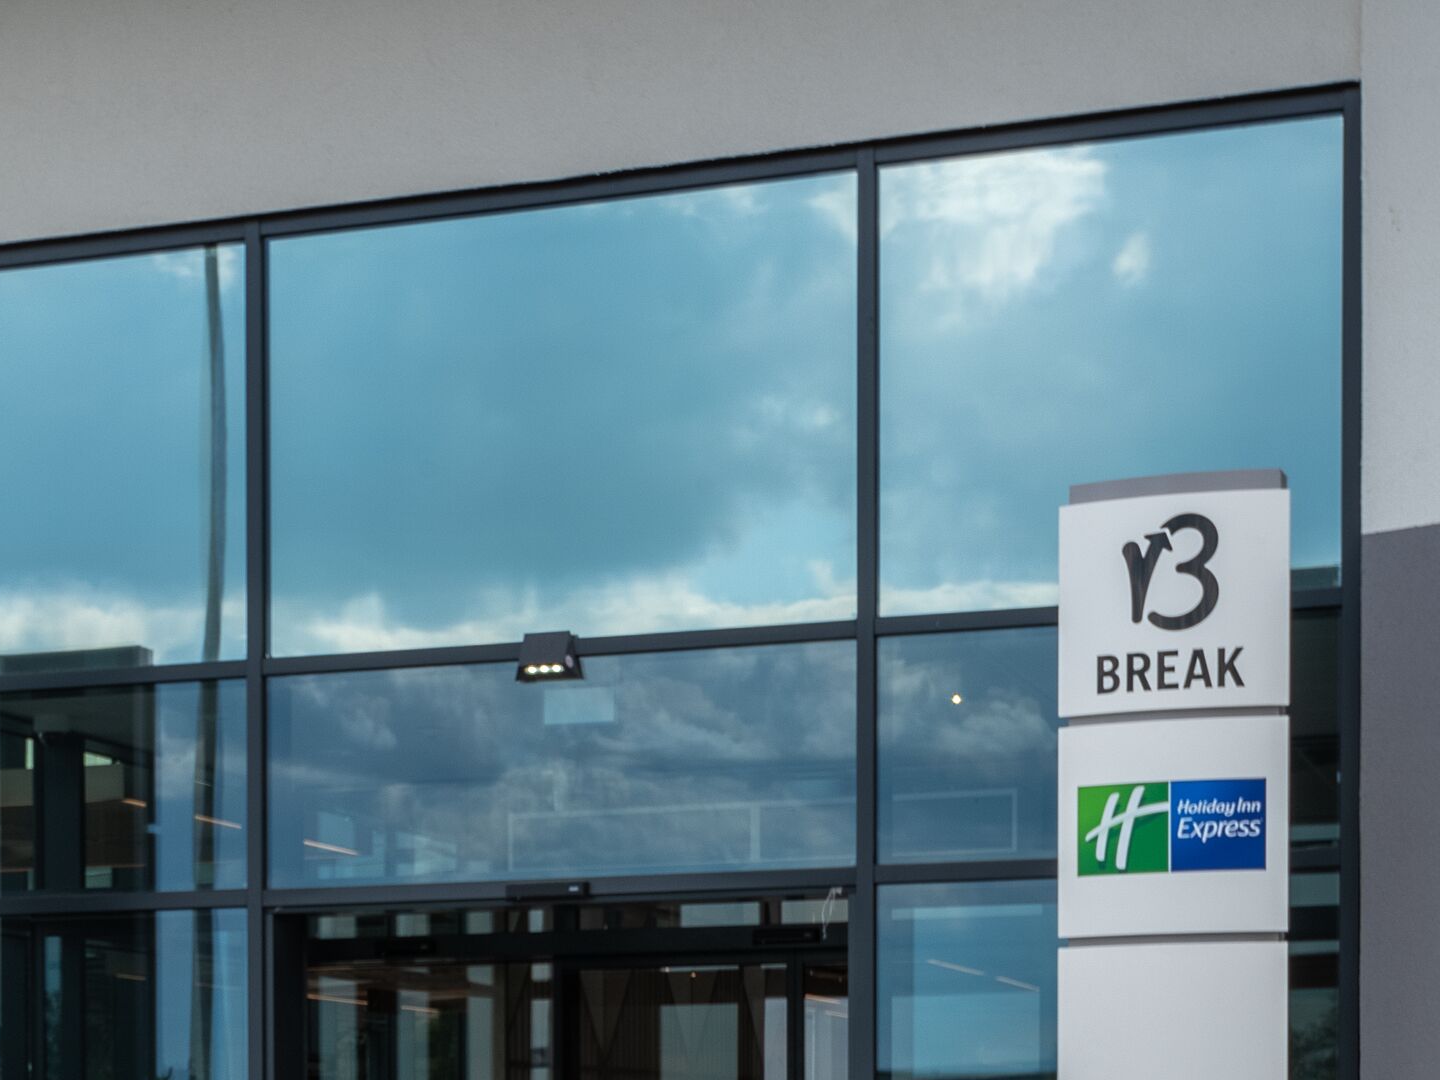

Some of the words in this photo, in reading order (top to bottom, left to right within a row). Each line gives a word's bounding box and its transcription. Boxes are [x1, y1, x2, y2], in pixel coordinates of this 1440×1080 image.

[1096, 646, 1245, 695] BREAK
[1177, 797, 1236, 817] Holiday
[1237, 796, 1262, 814] Inn
[1177, 816, 1262, 844] Express
